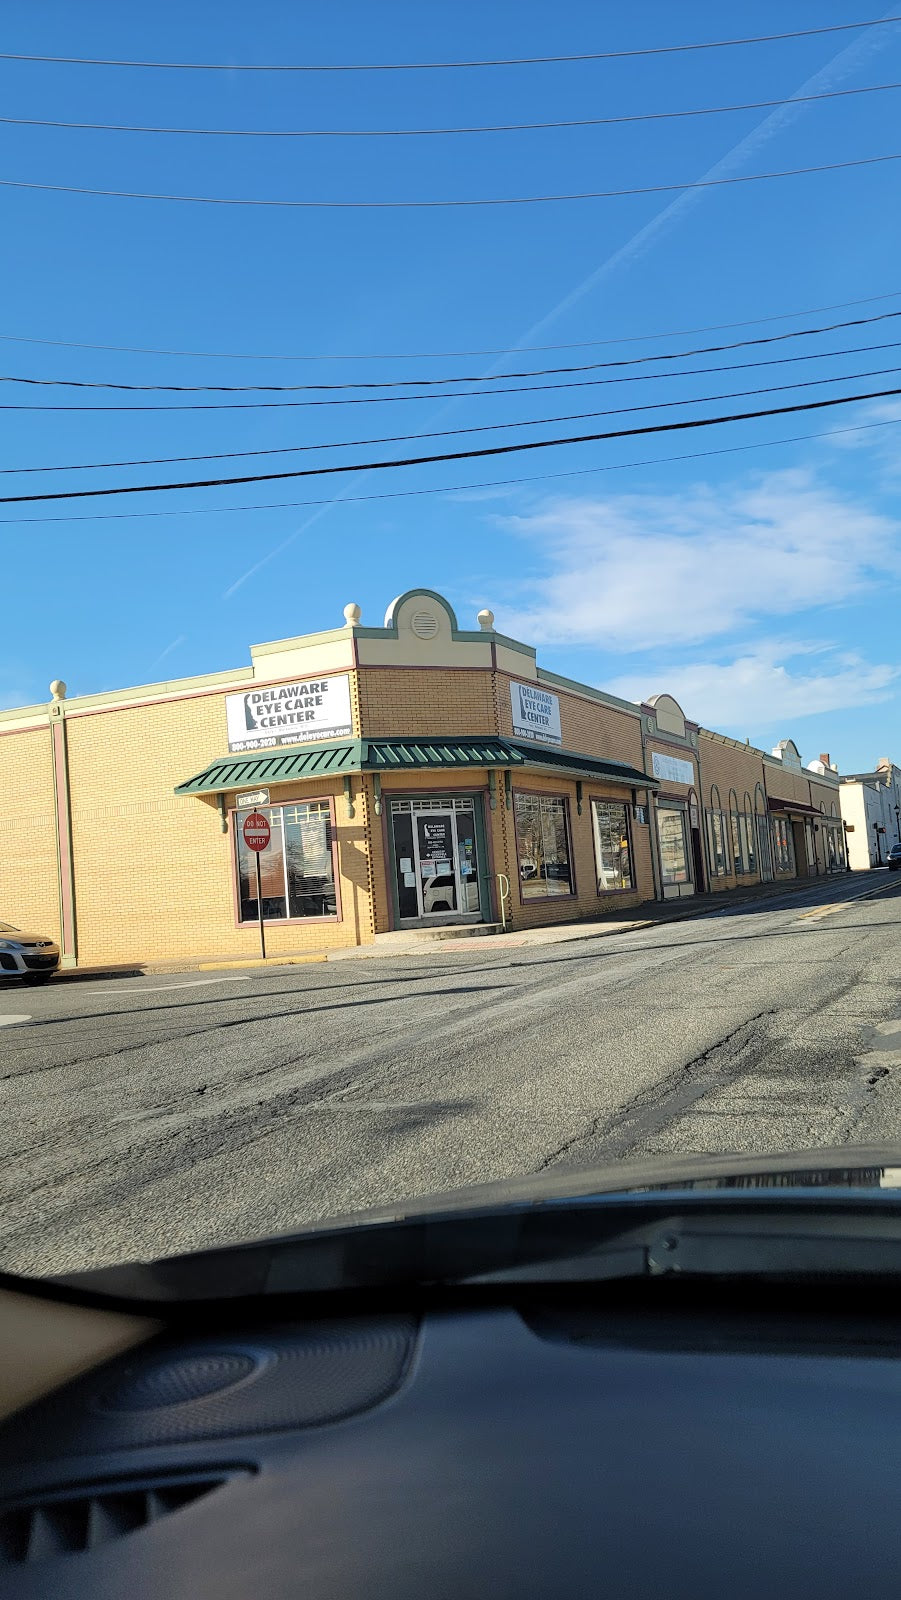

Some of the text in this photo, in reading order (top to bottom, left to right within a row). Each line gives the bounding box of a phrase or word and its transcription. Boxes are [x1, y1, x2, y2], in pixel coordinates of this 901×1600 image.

[251, 681, 329, 704] DELAWARE
[521, 686, 553, 705] DELAWARE
[256, 695, 323, 716] EYE CARE
[525, 699, 552, 715] EYE CARE
[260, 710, 315, 728] CENTER
[527, 711, 550, 726] CENTER
[231, 737, 277, 752] 800-900-2020
[240, 797, 250, 805] ONE
[250, 837, 266, 845] ENTER
